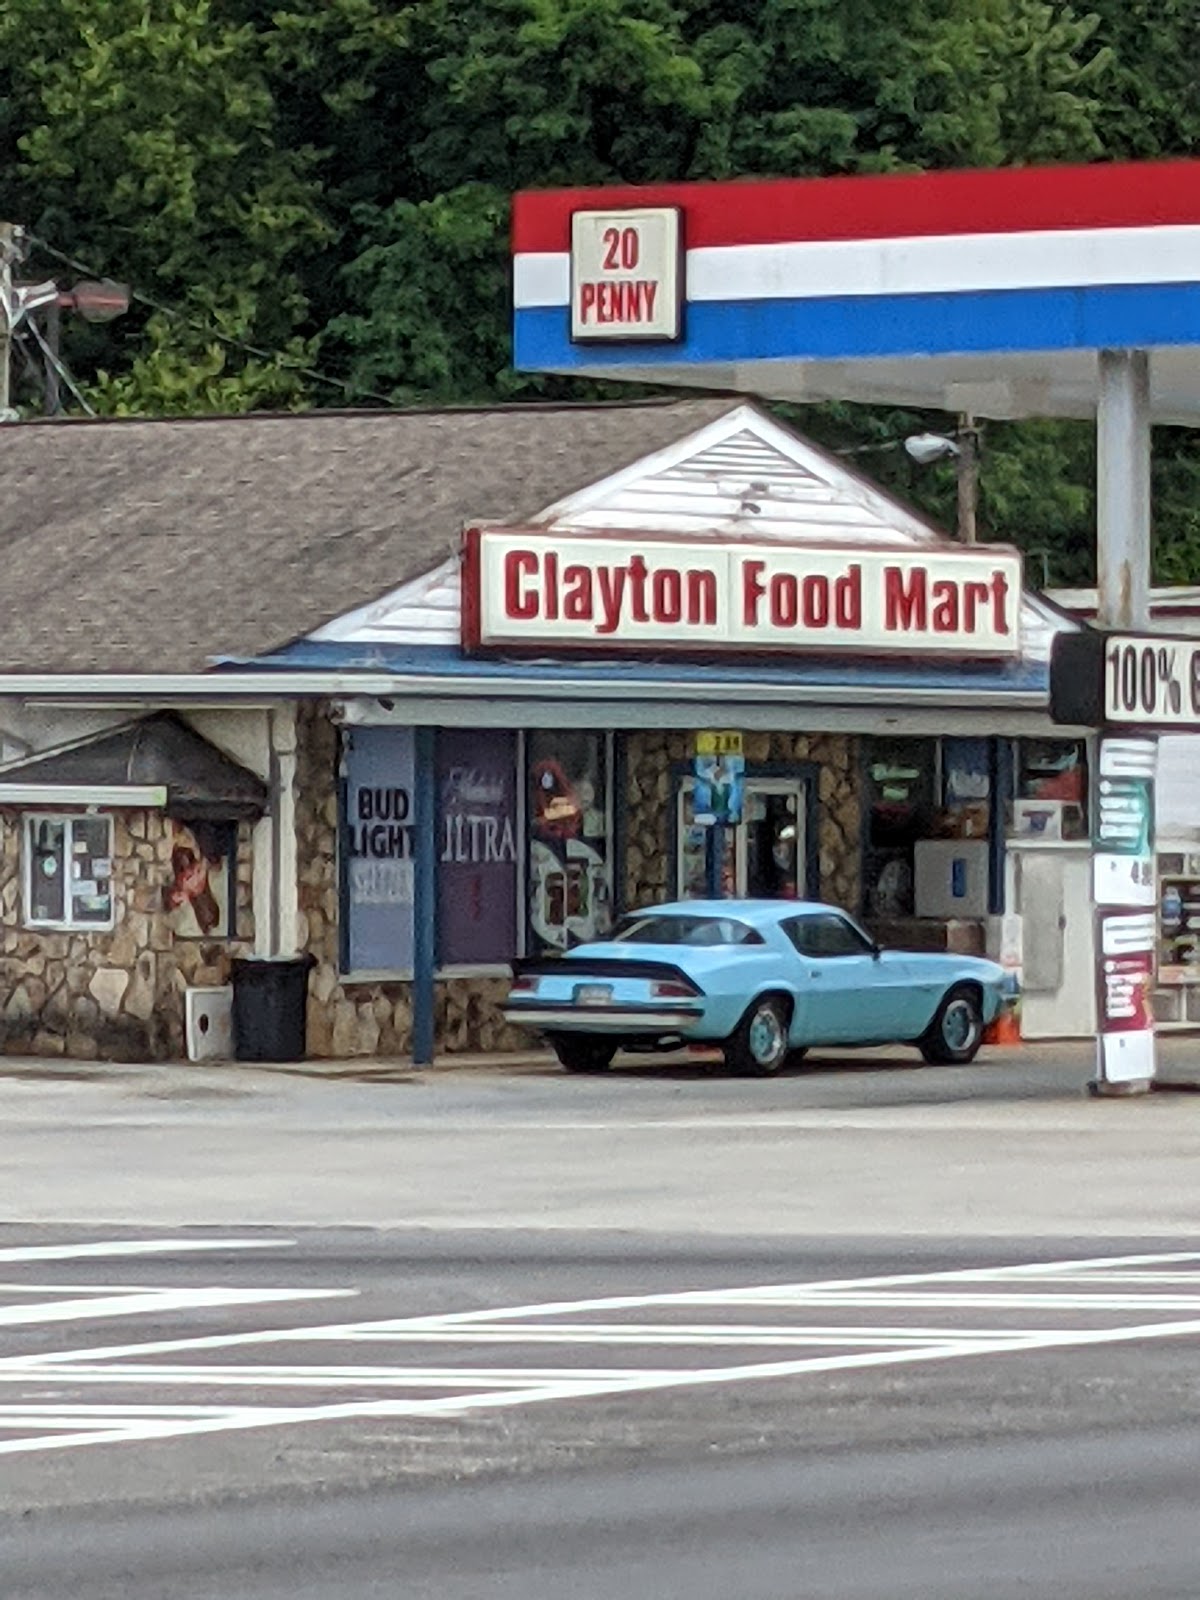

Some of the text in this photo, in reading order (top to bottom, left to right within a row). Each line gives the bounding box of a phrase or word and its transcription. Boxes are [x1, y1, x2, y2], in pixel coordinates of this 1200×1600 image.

[603, 227, 639, 270] 20
[580, 280, 658, 325] PENNY
[505, 550, 1009, 635] Clayton Food Mart
[1107, 644, 1182, 715] 100%
[358, 786, 409, 820] BUD
